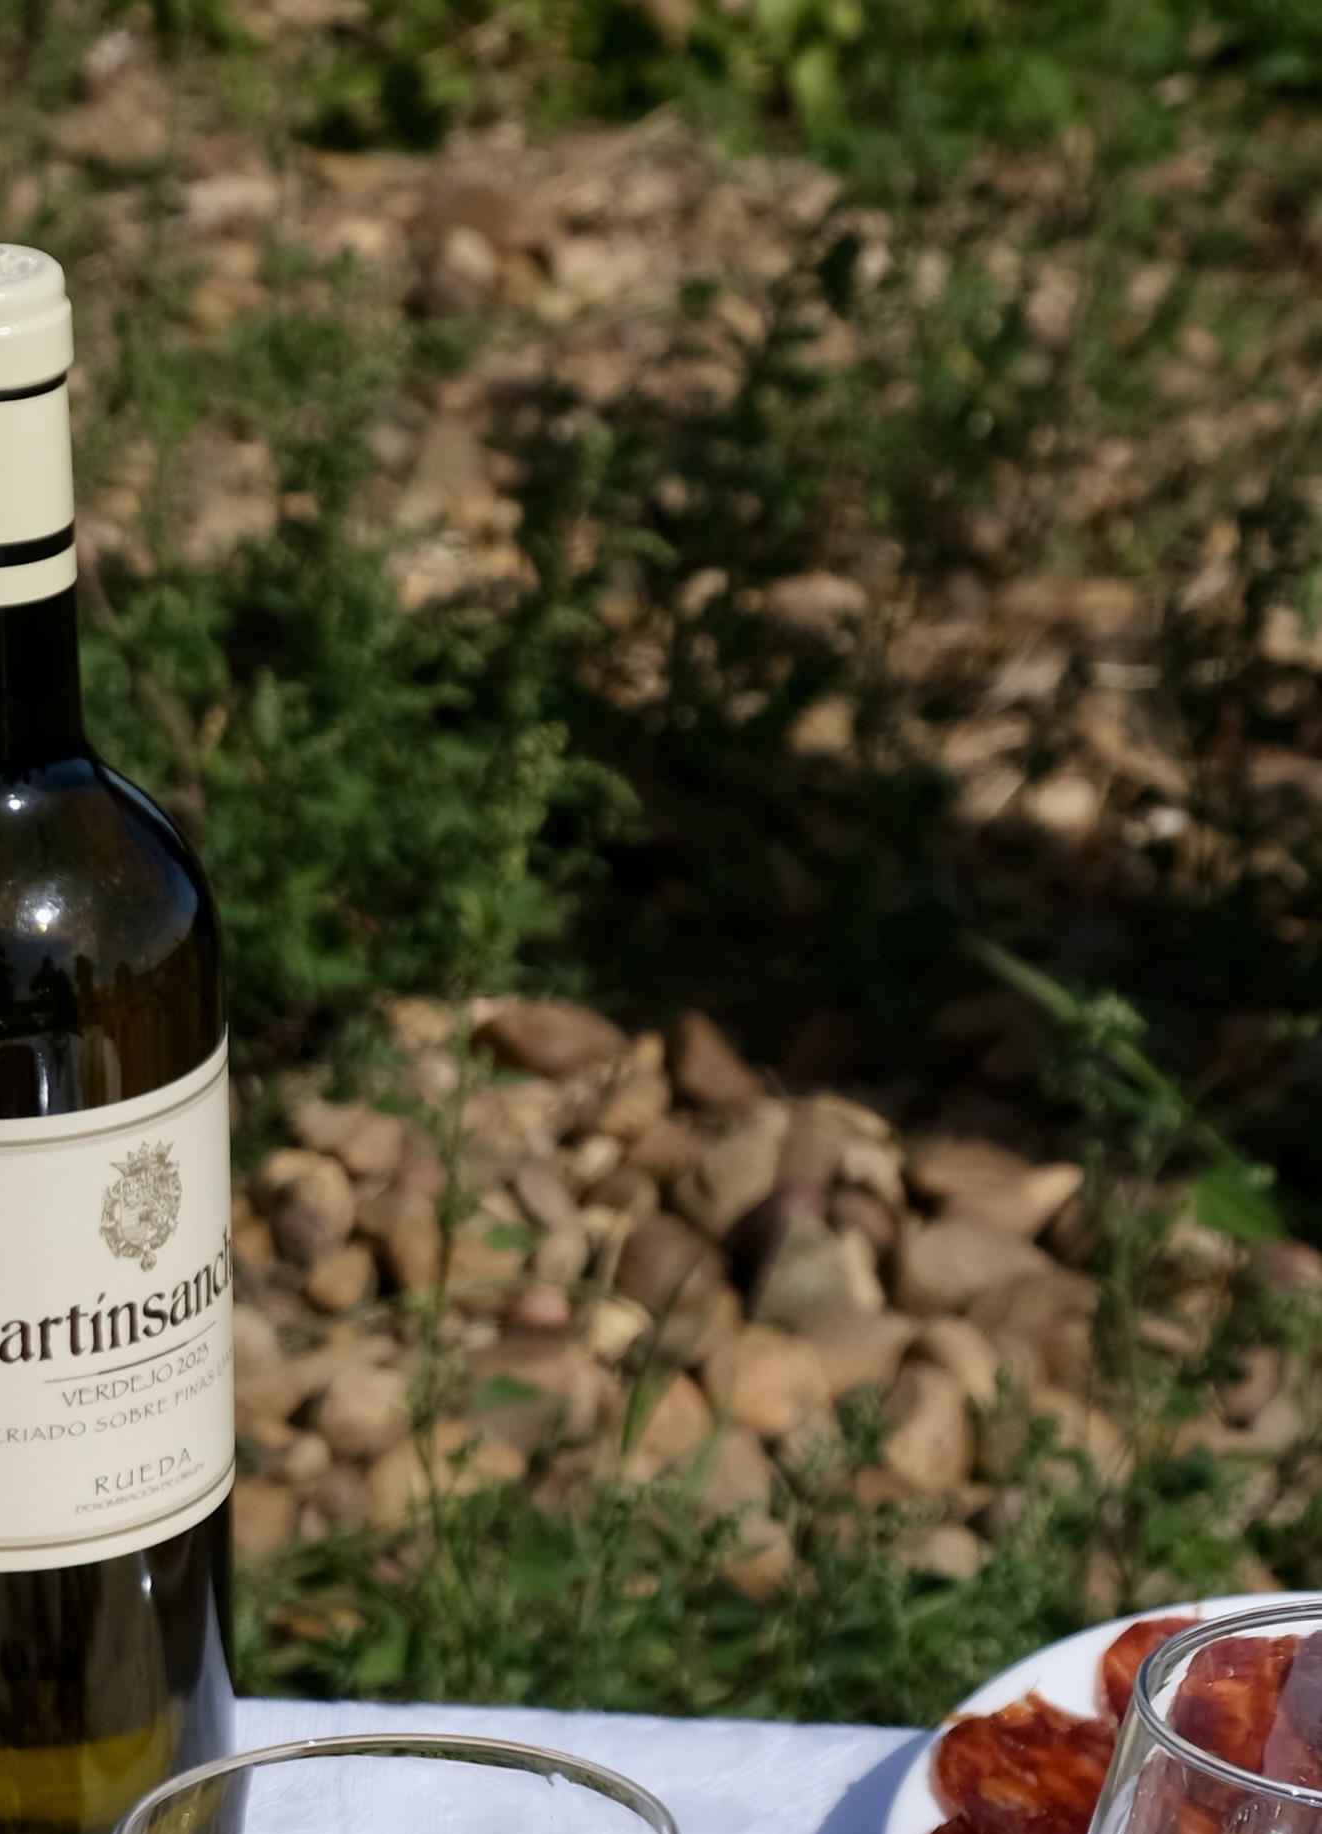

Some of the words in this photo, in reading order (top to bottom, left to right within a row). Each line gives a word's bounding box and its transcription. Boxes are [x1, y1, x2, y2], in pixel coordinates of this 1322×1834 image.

[61, 1362, 173, 1408] VERDEJO
[93, 1398, 168, 1434] SOBRE
[174, 1371, 215, 1407] FINAS
[93, 1446, 194, 1497] RUEDA
